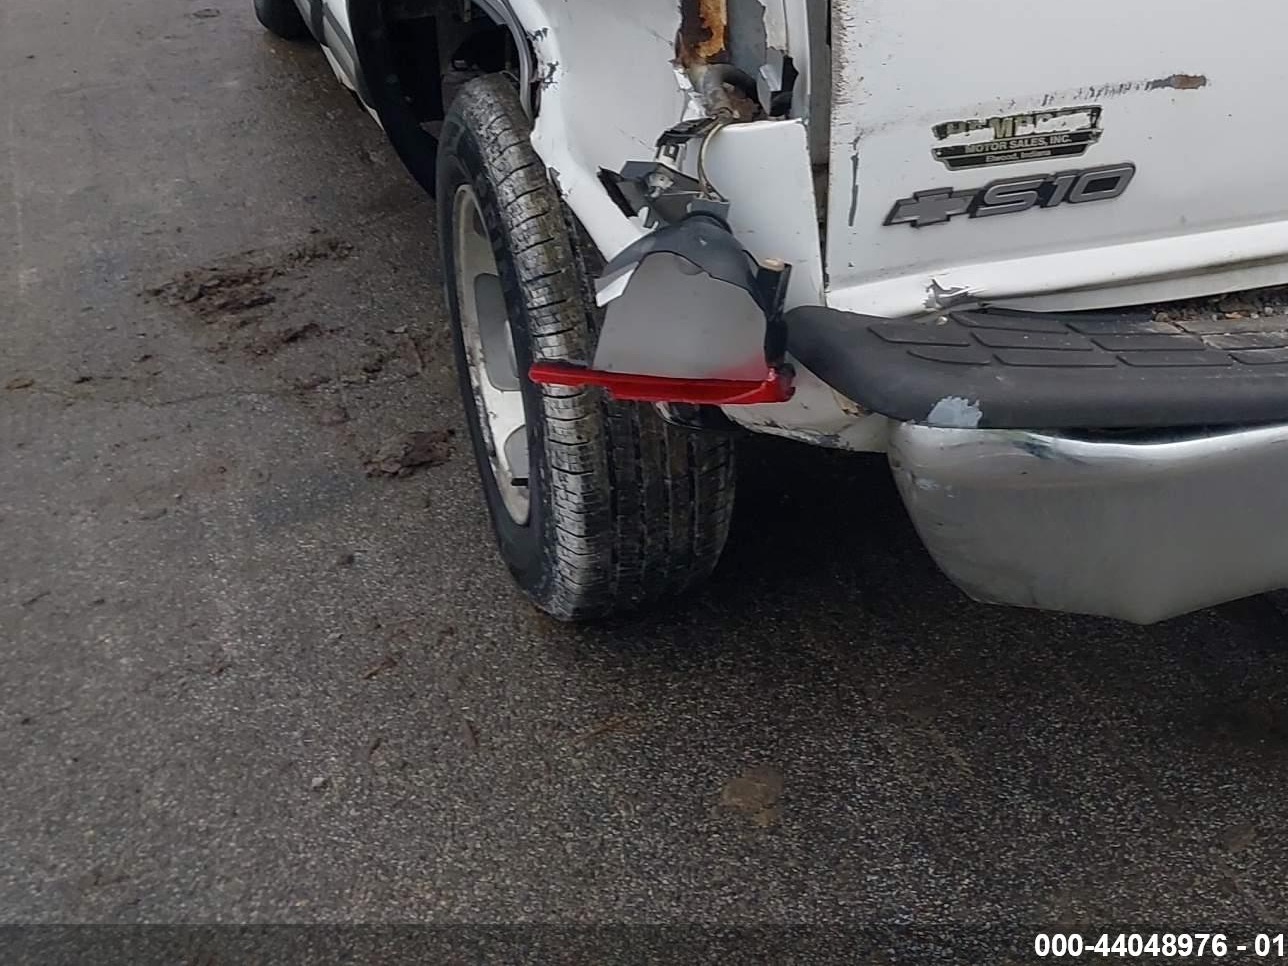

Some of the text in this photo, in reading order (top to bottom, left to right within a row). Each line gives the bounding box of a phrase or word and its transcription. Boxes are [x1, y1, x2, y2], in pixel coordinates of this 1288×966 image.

[965, 135, 1072, 153] MOTOR SALES, INC.
[974, 162, 1136, 218] S10
